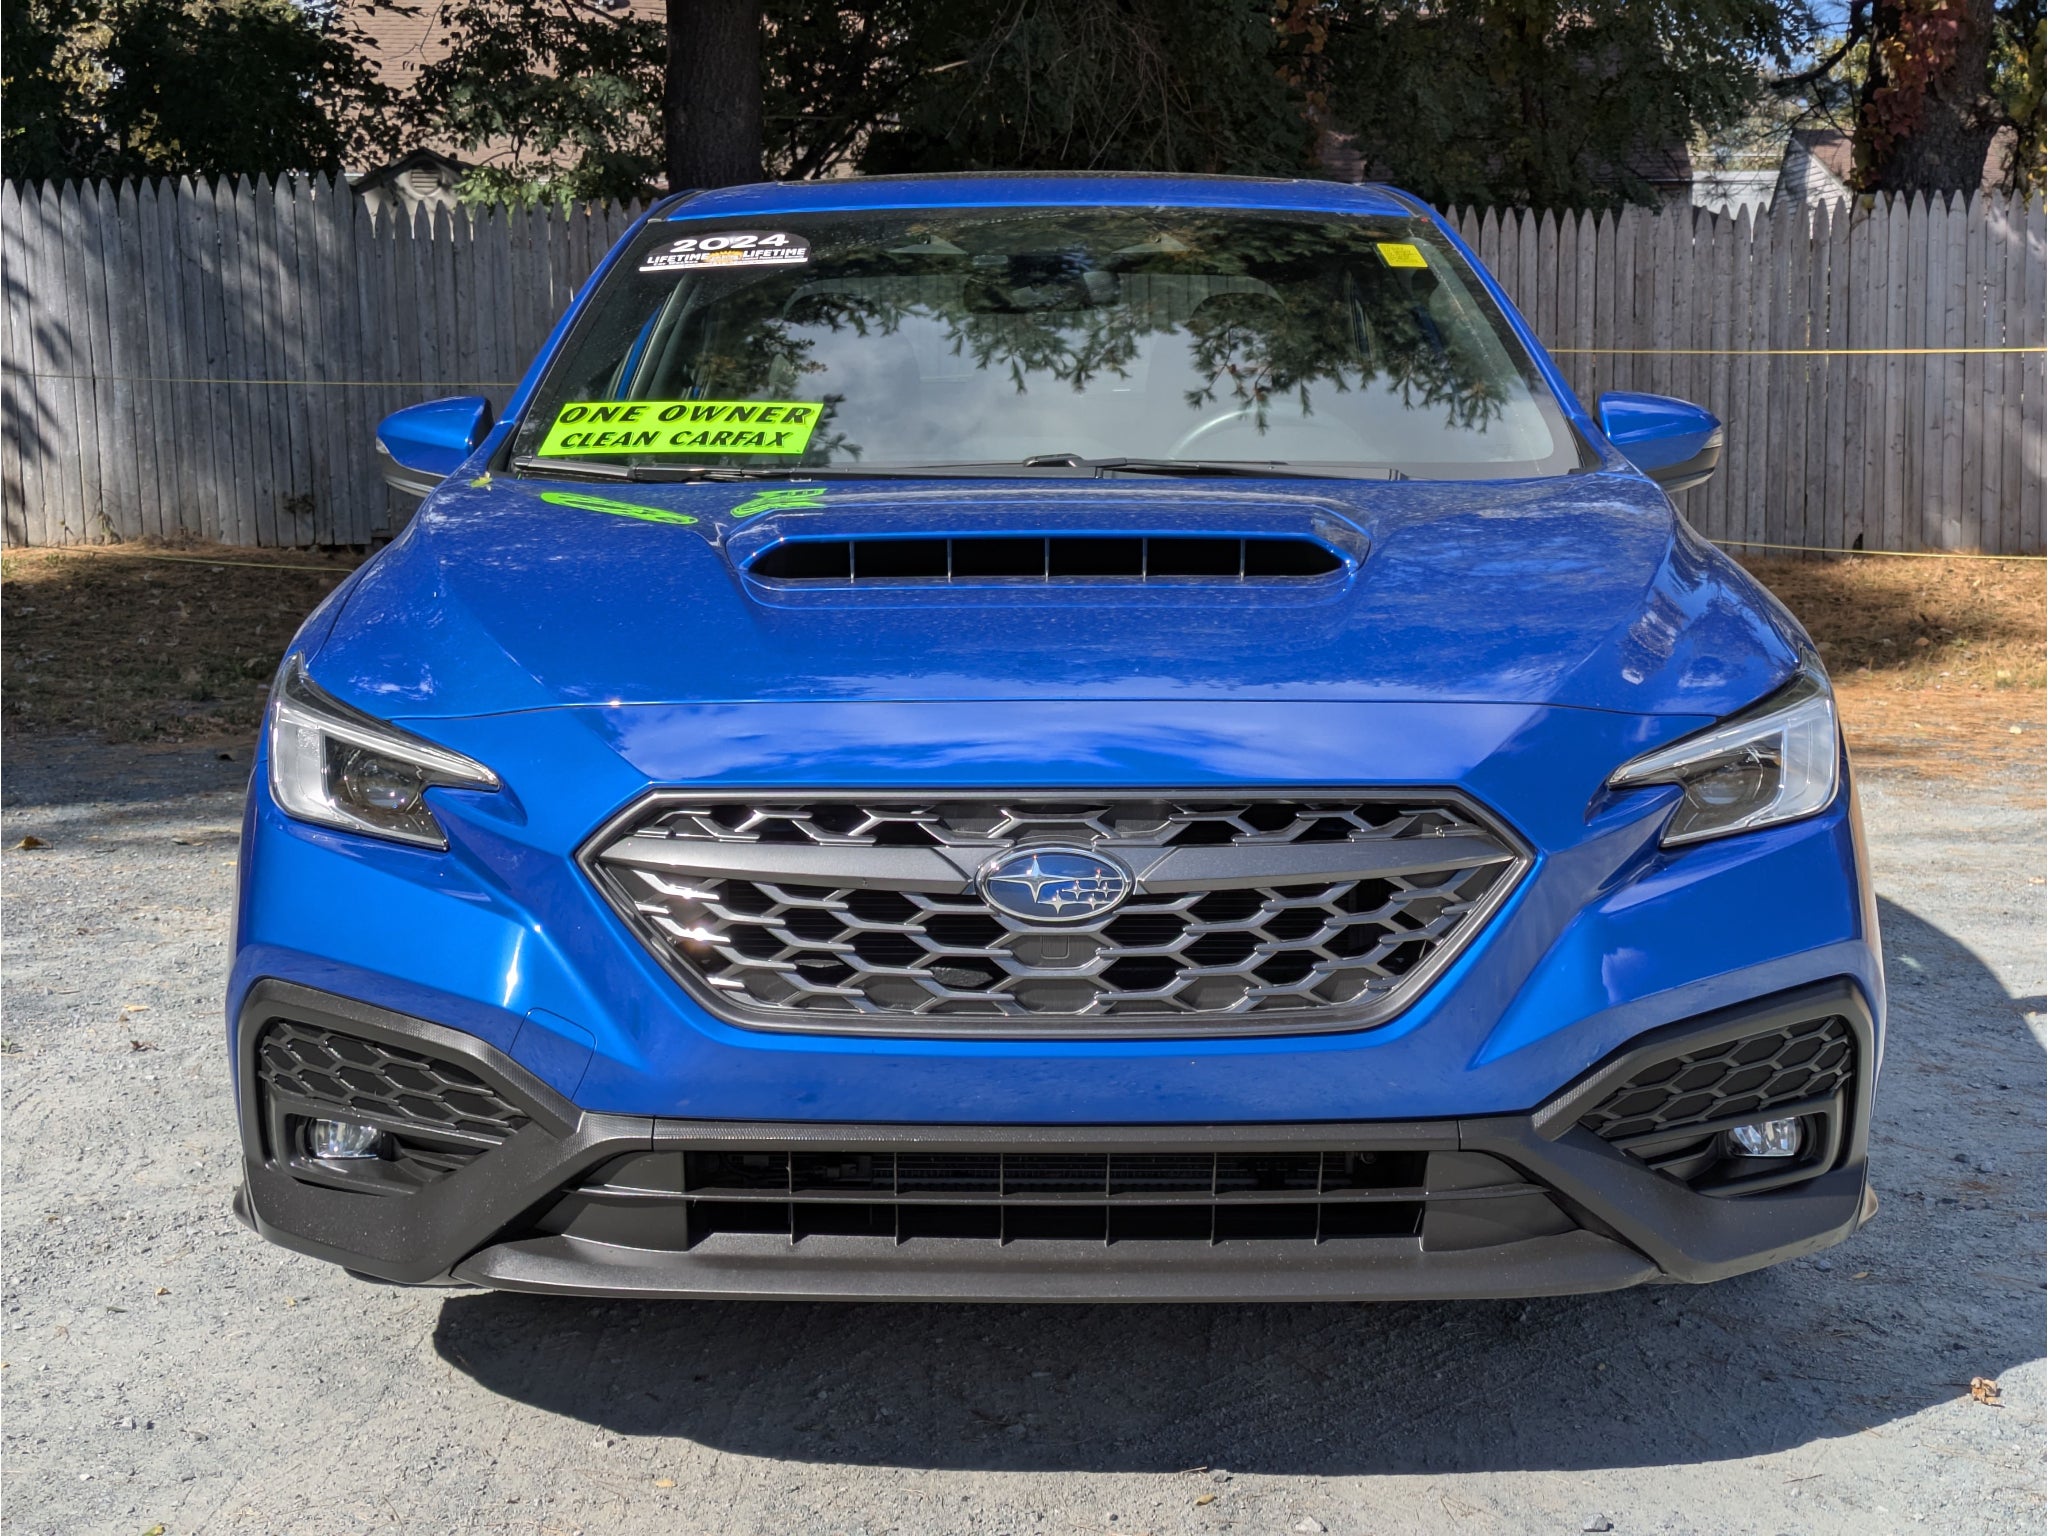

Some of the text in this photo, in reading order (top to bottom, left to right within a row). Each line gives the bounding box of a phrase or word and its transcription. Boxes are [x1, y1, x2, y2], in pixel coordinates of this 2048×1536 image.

[670, 234, 789, 252] 2024
[647, 253, 709, 264] LIFETIME
[743, 248, 807, 258] LIFETIME
[559, 404, 814, 425] ONE OWNER
[560, 430, 794, 449] CLEAN CARFAX
